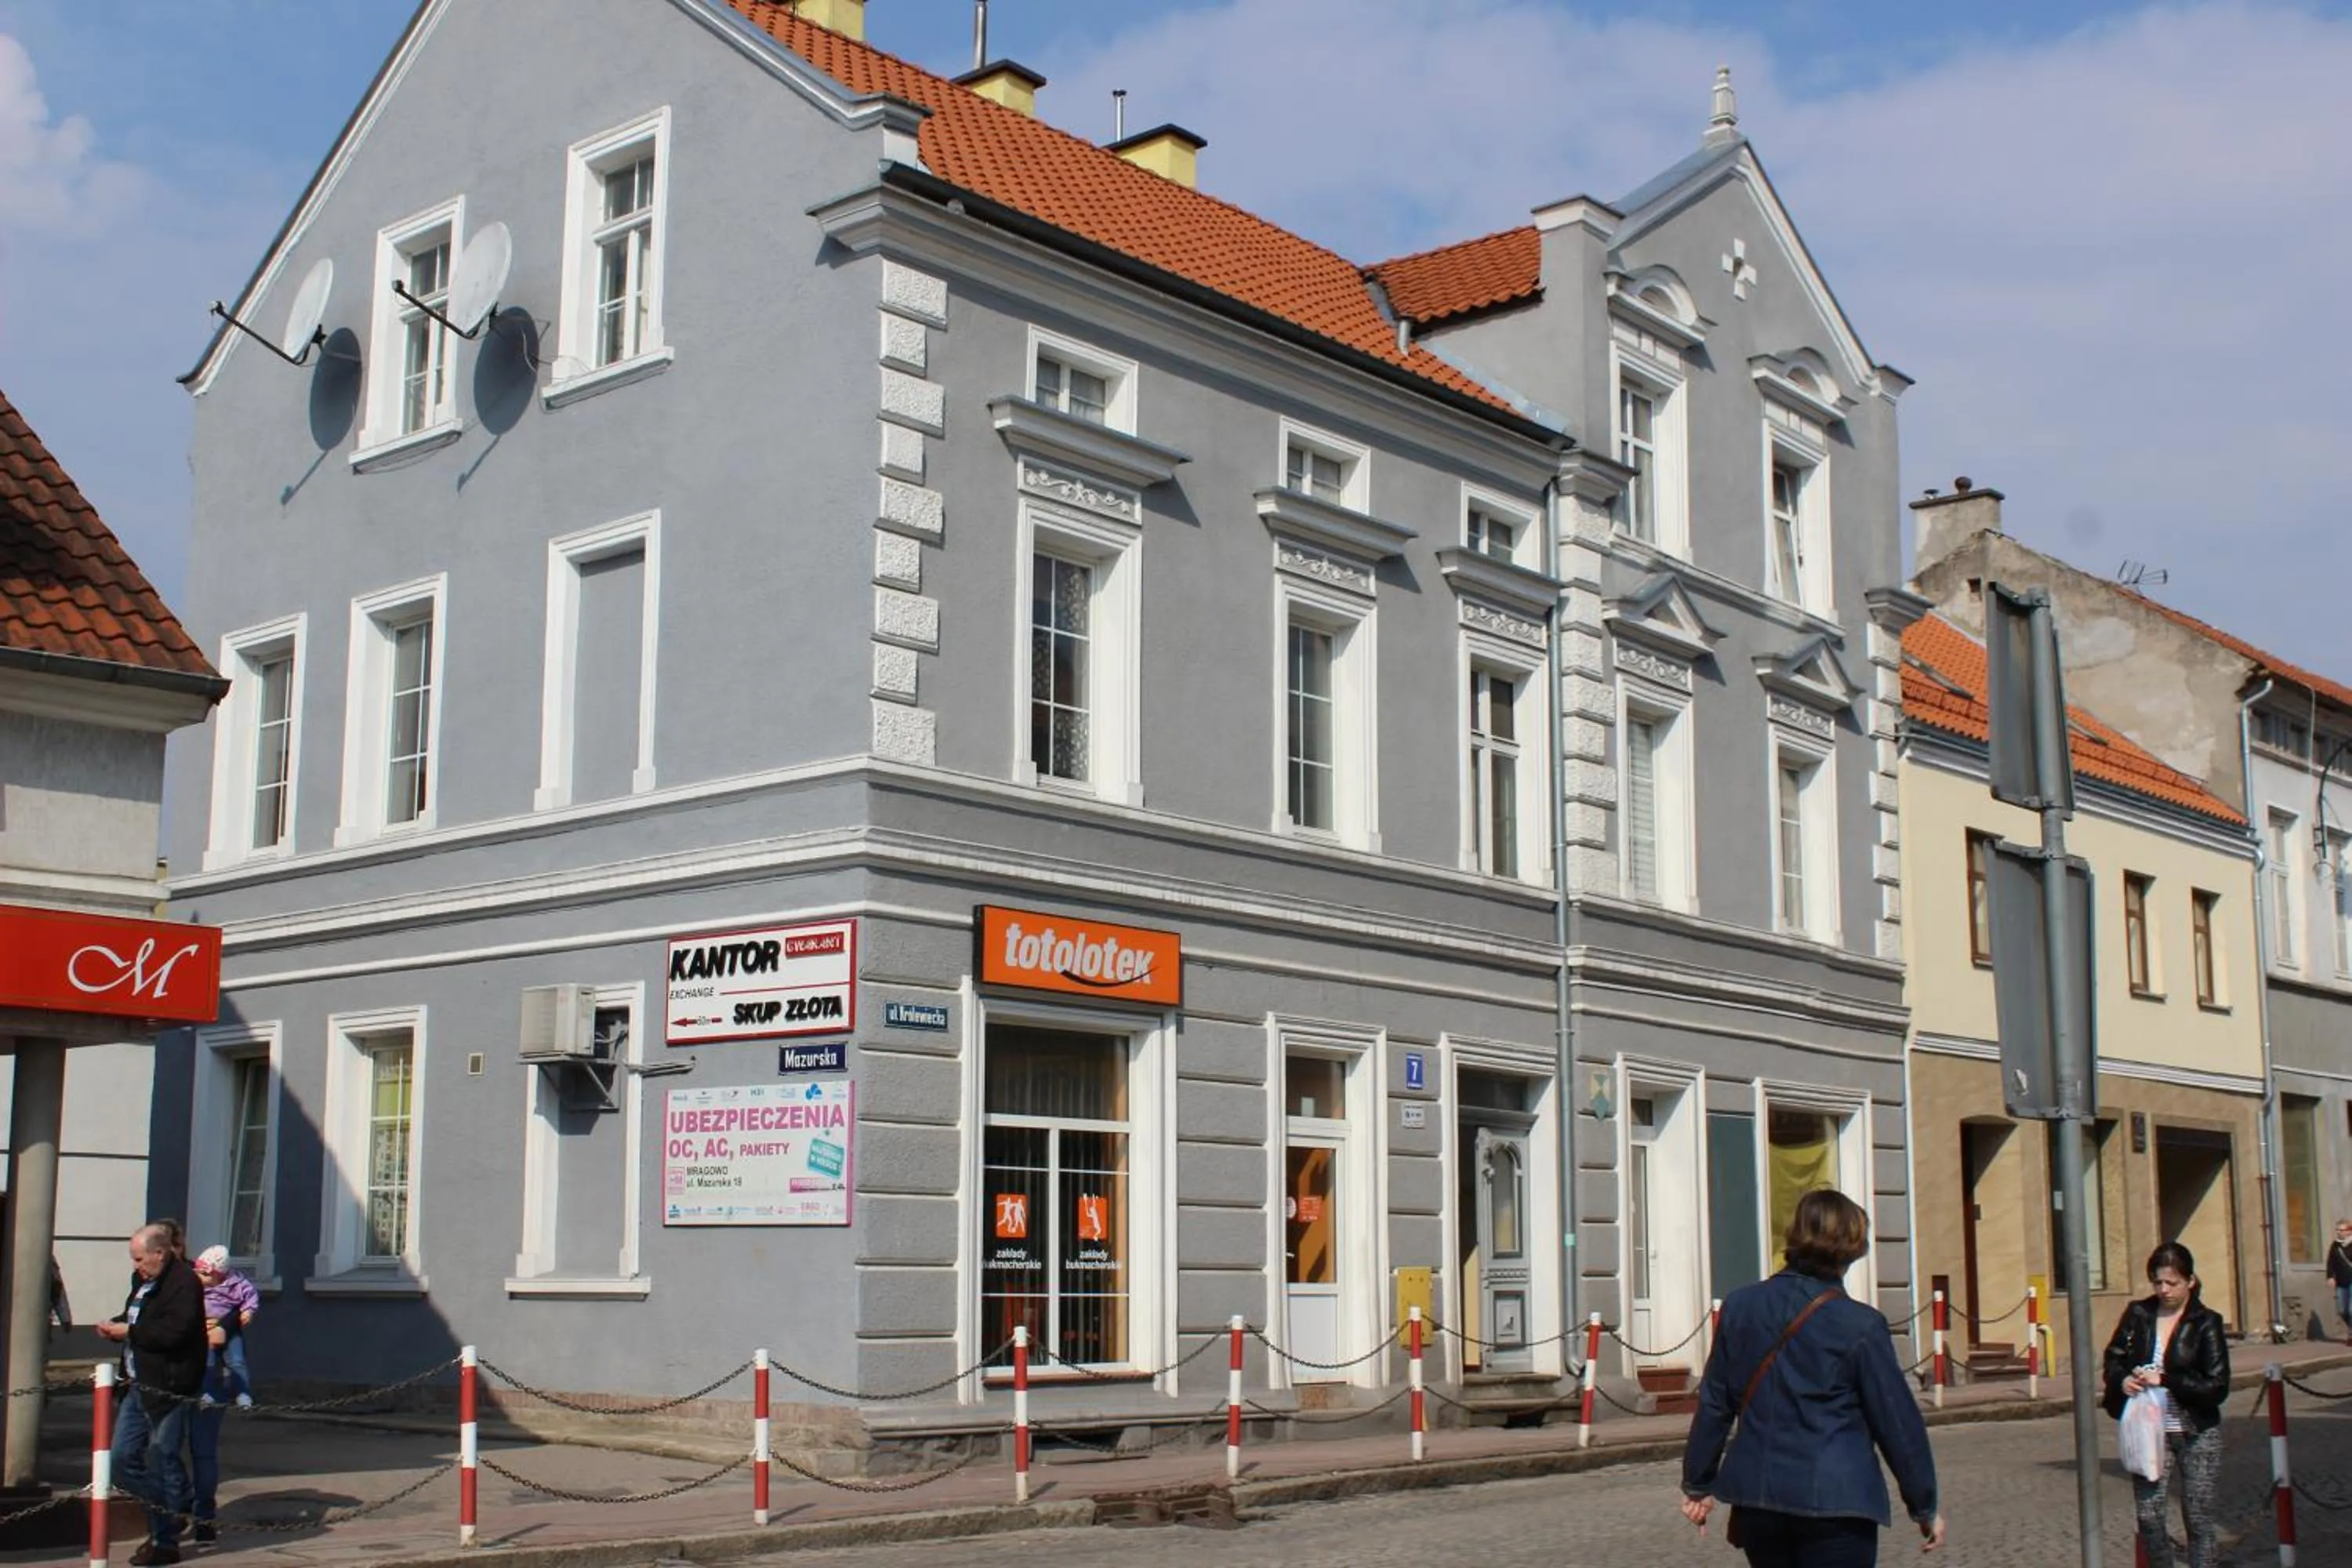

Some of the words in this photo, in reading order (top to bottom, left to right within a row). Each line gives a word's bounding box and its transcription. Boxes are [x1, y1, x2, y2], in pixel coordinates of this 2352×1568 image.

[67, 938, 199, 998] M
[669, 940, 781, 981] KANTOR
[1004, 923, 1155, 985] totolotek
[670, 987, 714, 999] EXCHANGE
[733, 1001, 781, 1025] SKUP
[785, 996, 843, 1022] ZŁOTA
[785, 1048, 837, 1068] Mazurska
[1411, 1061, 1418, 1080] 7
[670, 1104, 845, 1134] UBEZPIECZENIA
[669, 1139, 699, 1162] OC,
[704, 1138, 734, 1160] AC,
[740, 1142, 790, 1156] PAKIETY
